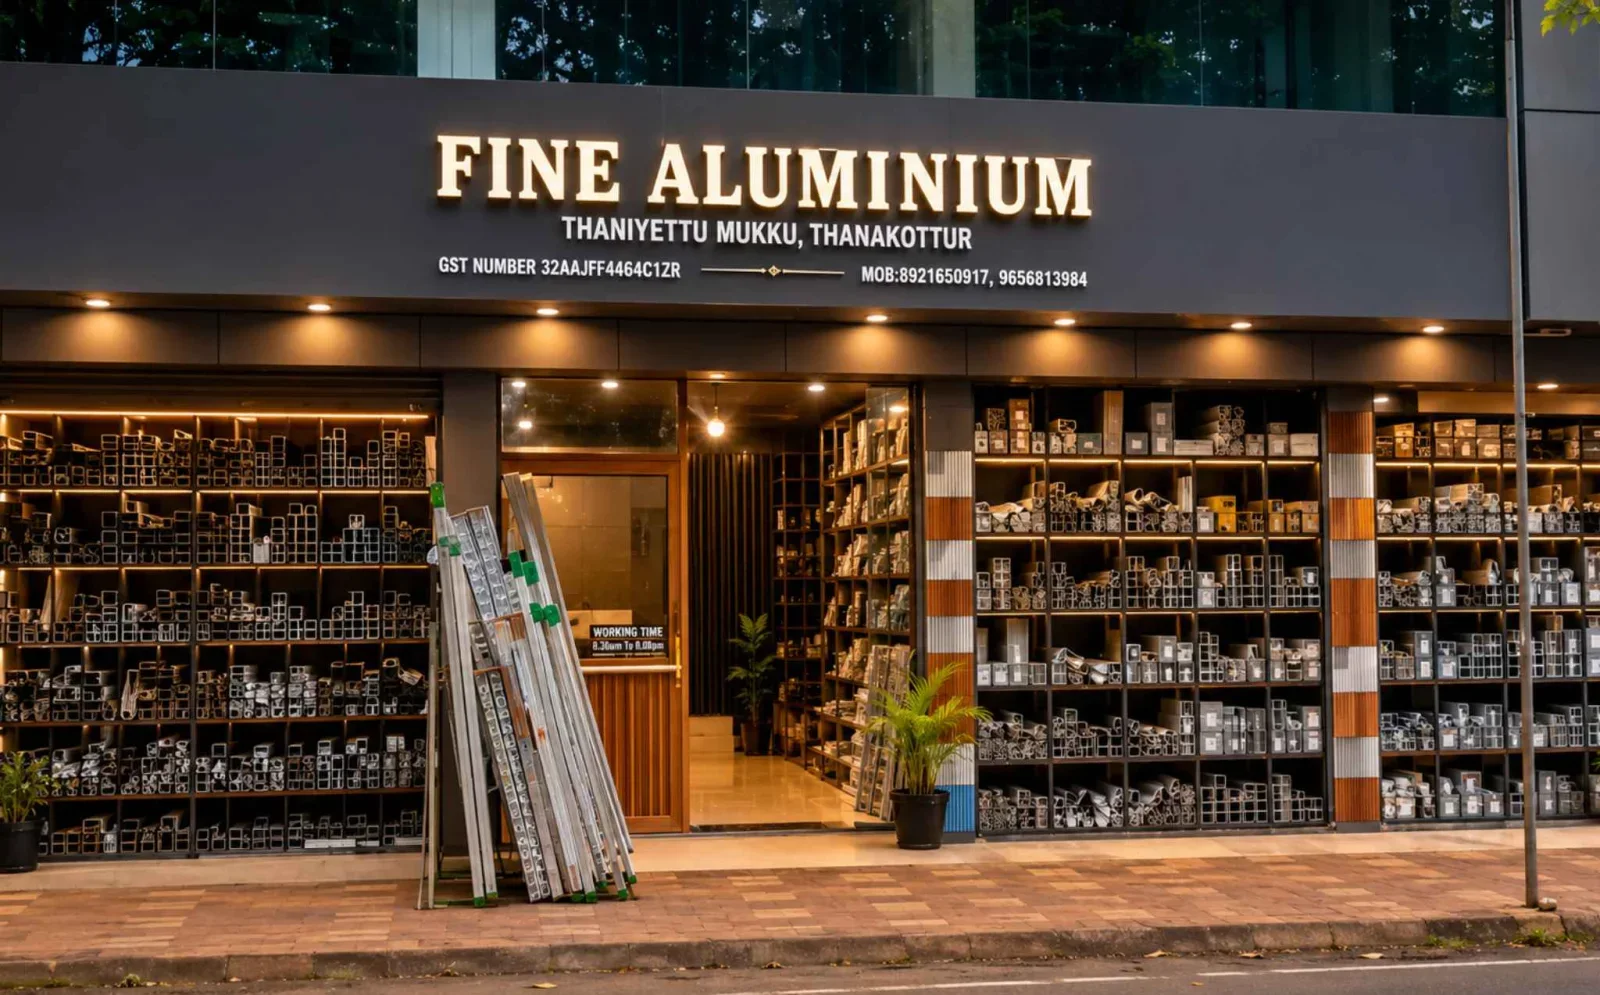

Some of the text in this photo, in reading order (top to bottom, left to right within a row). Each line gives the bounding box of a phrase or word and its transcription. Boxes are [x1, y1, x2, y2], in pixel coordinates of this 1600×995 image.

[437, 135, 1092, 217] FINE ALUMINIUM
[561, 216, 973, 250] THANIYETTU MUKKU, THANAKOTTUR
[438, 257, 681, 278] GST NUMBER 32AAJFF4464C1ZR
[861, 266, 1088, 288] MOB:8921650917, 9656813984
[593, 626, 664, 637] WORKING TIME
